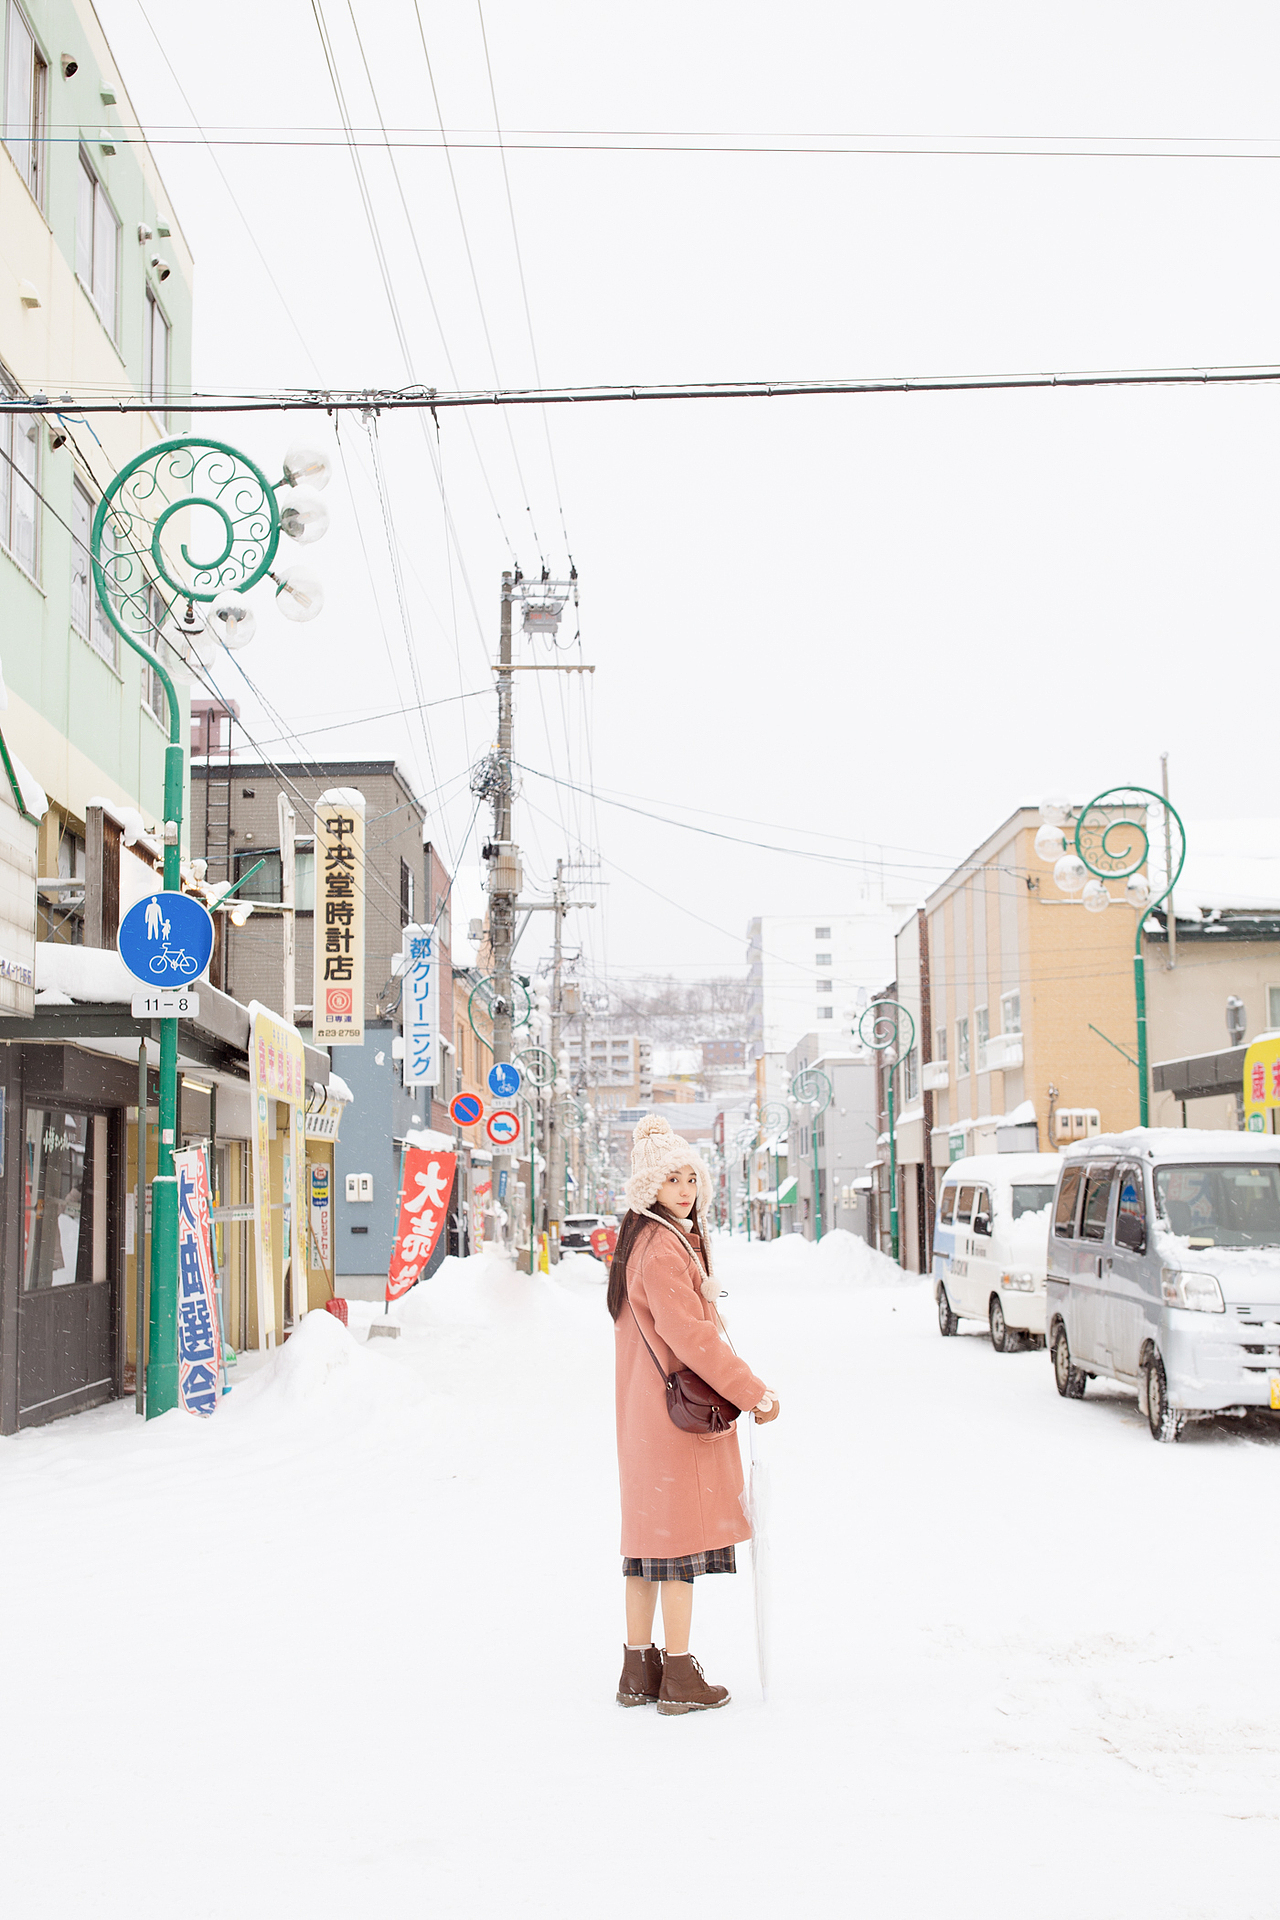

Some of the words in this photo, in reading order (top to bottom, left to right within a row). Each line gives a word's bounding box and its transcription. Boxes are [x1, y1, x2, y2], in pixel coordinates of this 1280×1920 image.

[323, 814, 355, 981] 中央堂時計店
[145, 998, 189, 1011] 11-8
[410, 937, 431, 1076] 都クリーニング
